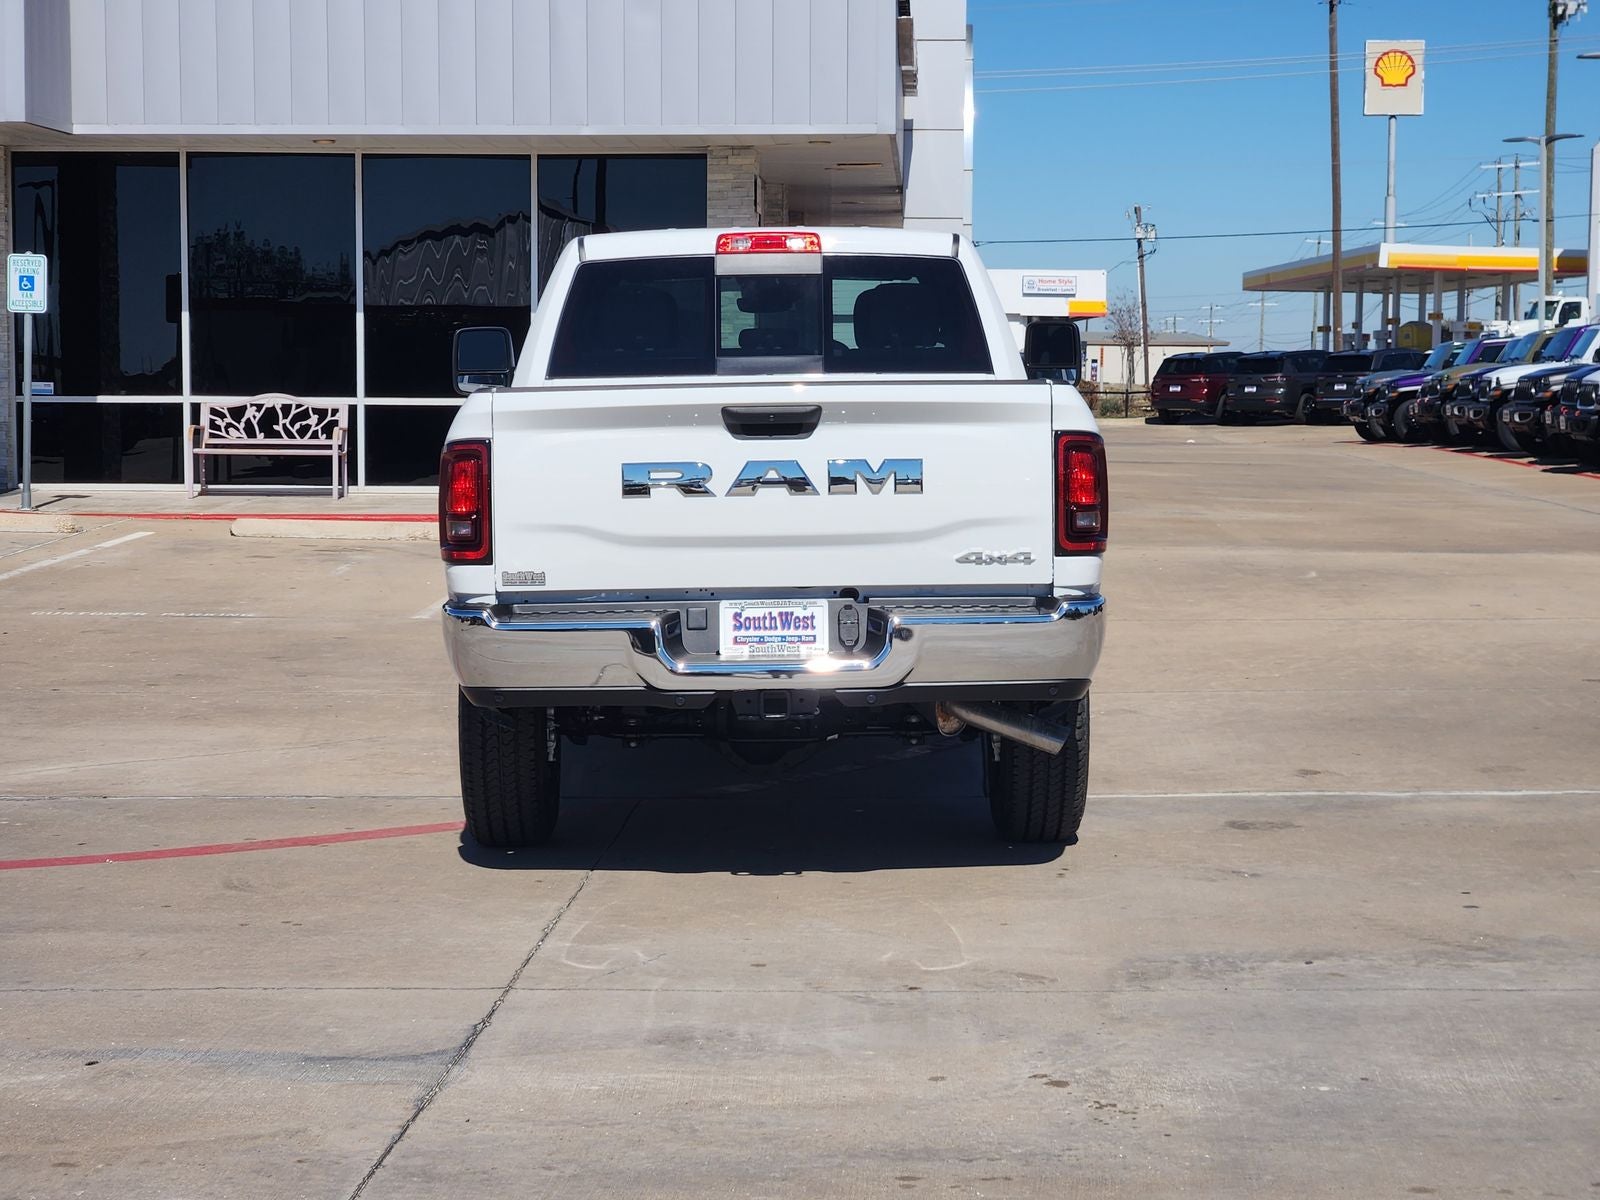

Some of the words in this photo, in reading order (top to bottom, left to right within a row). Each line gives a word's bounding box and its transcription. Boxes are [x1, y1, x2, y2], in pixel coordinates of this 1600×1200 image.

[12, 259, 42, 267] RESERVED
[11, 300, 43, 308] ACCESSIBLE
[621, 458, 924, 499] RAM
[955, 552, 1036, 566] 4x4
[732, 611, 816, 631] SouthWest
[736, 635, 760, 643] Chrysler
